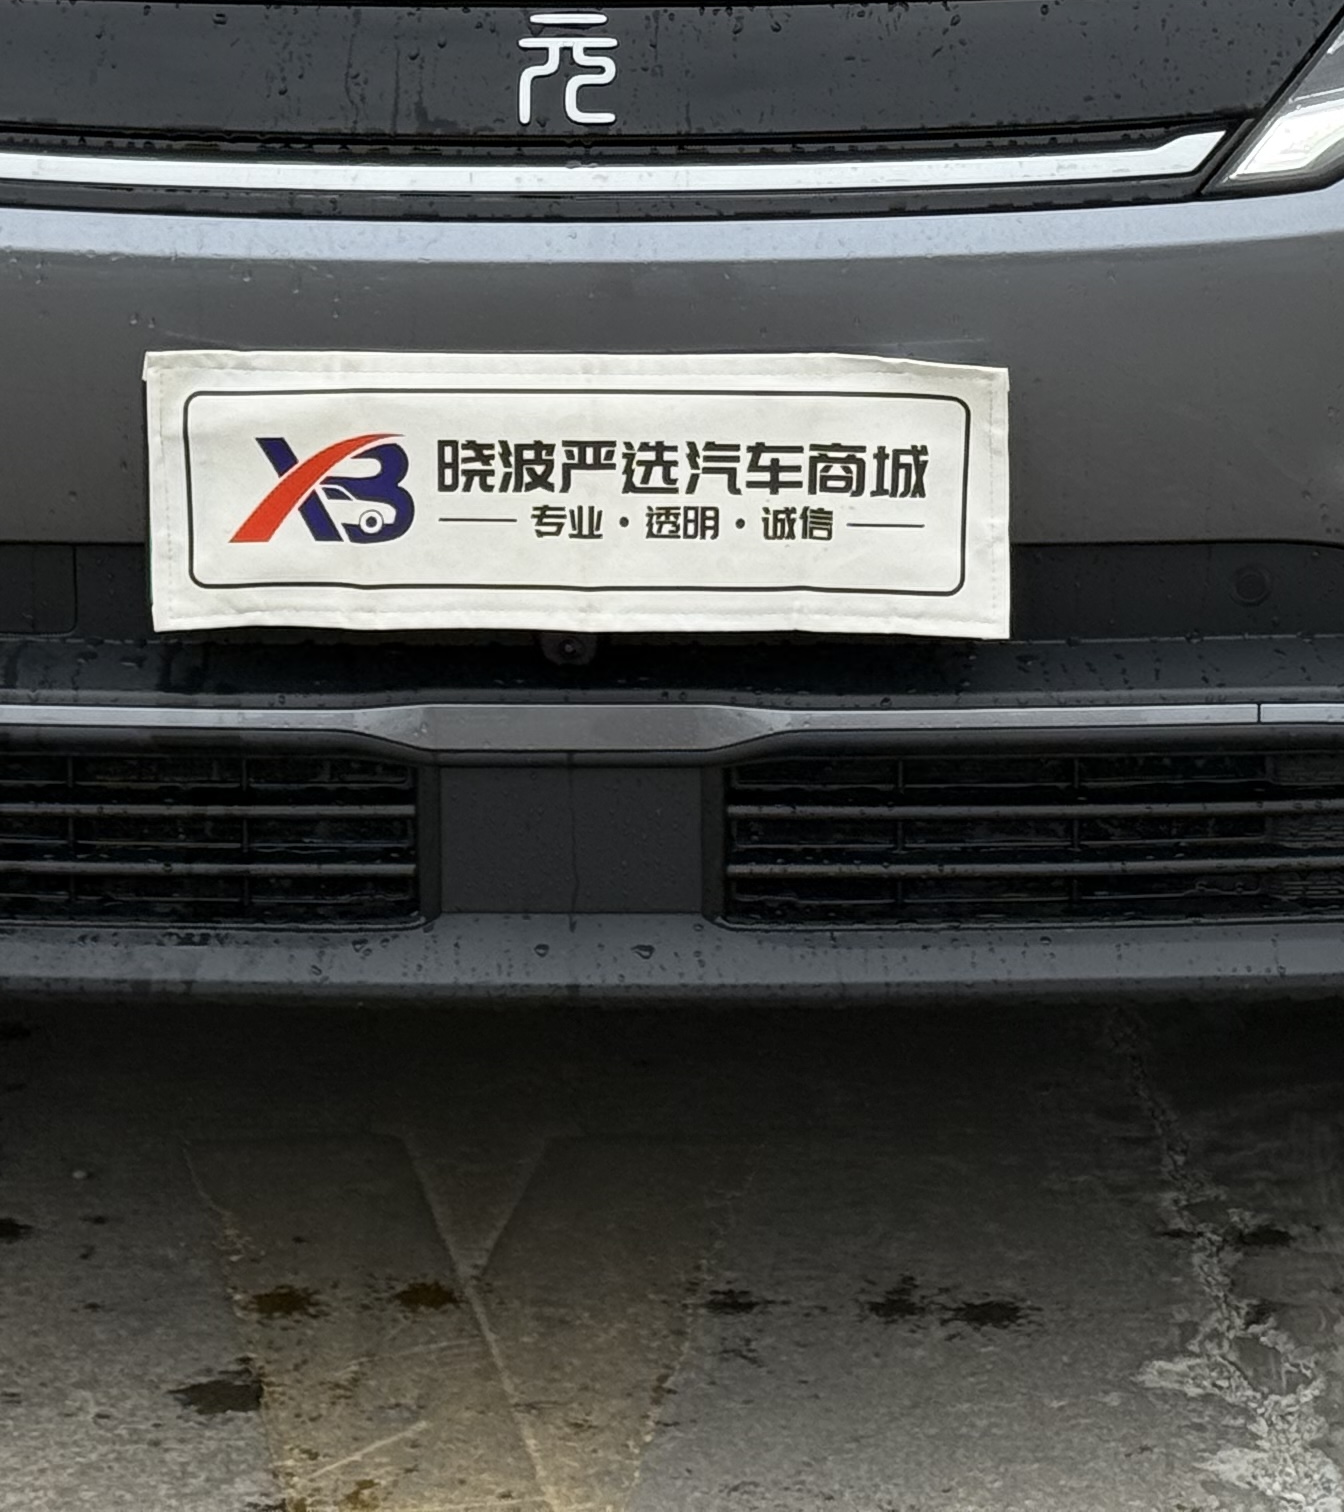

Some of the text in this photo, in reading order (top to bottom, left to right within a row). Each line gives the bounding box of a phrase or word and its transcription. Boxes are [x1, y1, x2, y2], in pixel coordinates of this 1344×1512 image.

[437, 439, 930, 498] 晓波严选汽车商城
